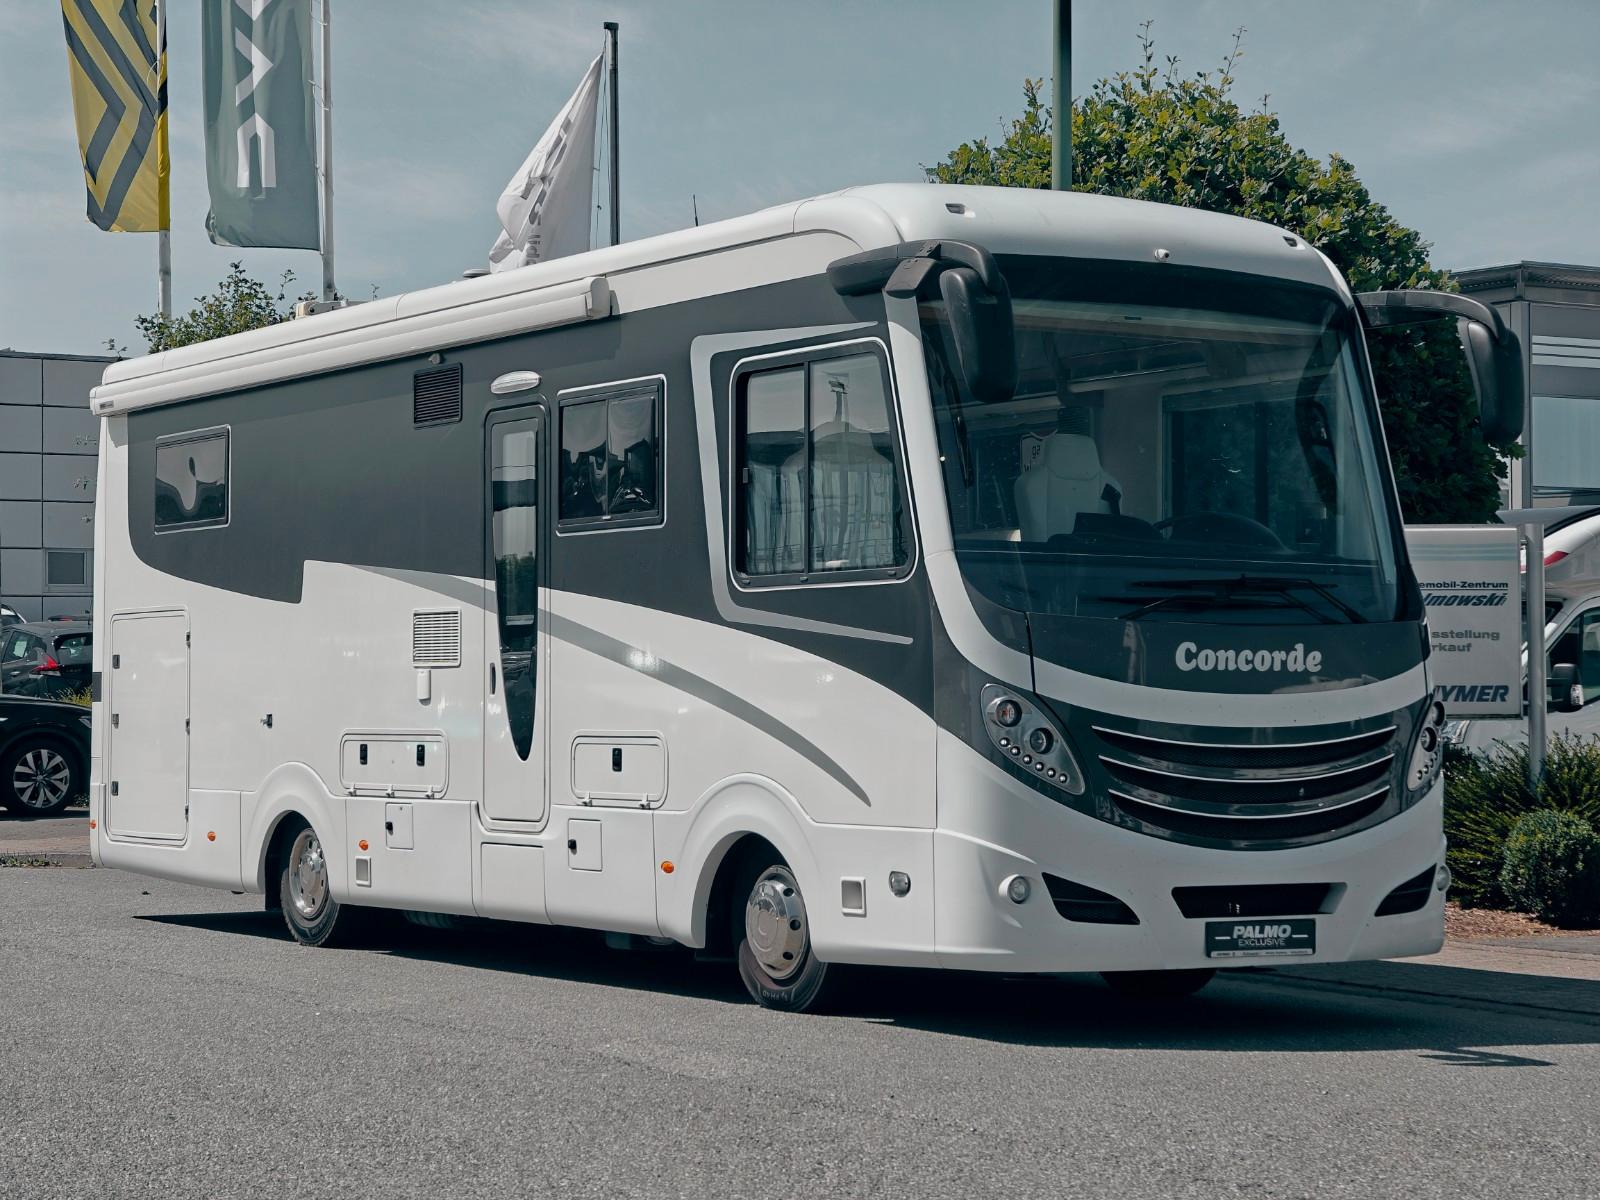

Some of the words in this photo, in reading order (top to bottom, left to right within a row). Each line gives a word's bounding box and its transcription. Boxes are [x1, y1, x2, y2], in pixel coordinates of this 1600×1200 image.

[1419, 581, 1508, 589] emobil-Zentrum
[1424, 593, 1509, 607] lmowski
[1431, 629, 1500, 641] sstellung
[1431, 643, 1473, 652] rkauf
[1175, 641, 1323, 673] Concorde
[1232, 924, 1292, 939] PALMO
[1238, 938, 1287, 947] EXCLUSIVE
